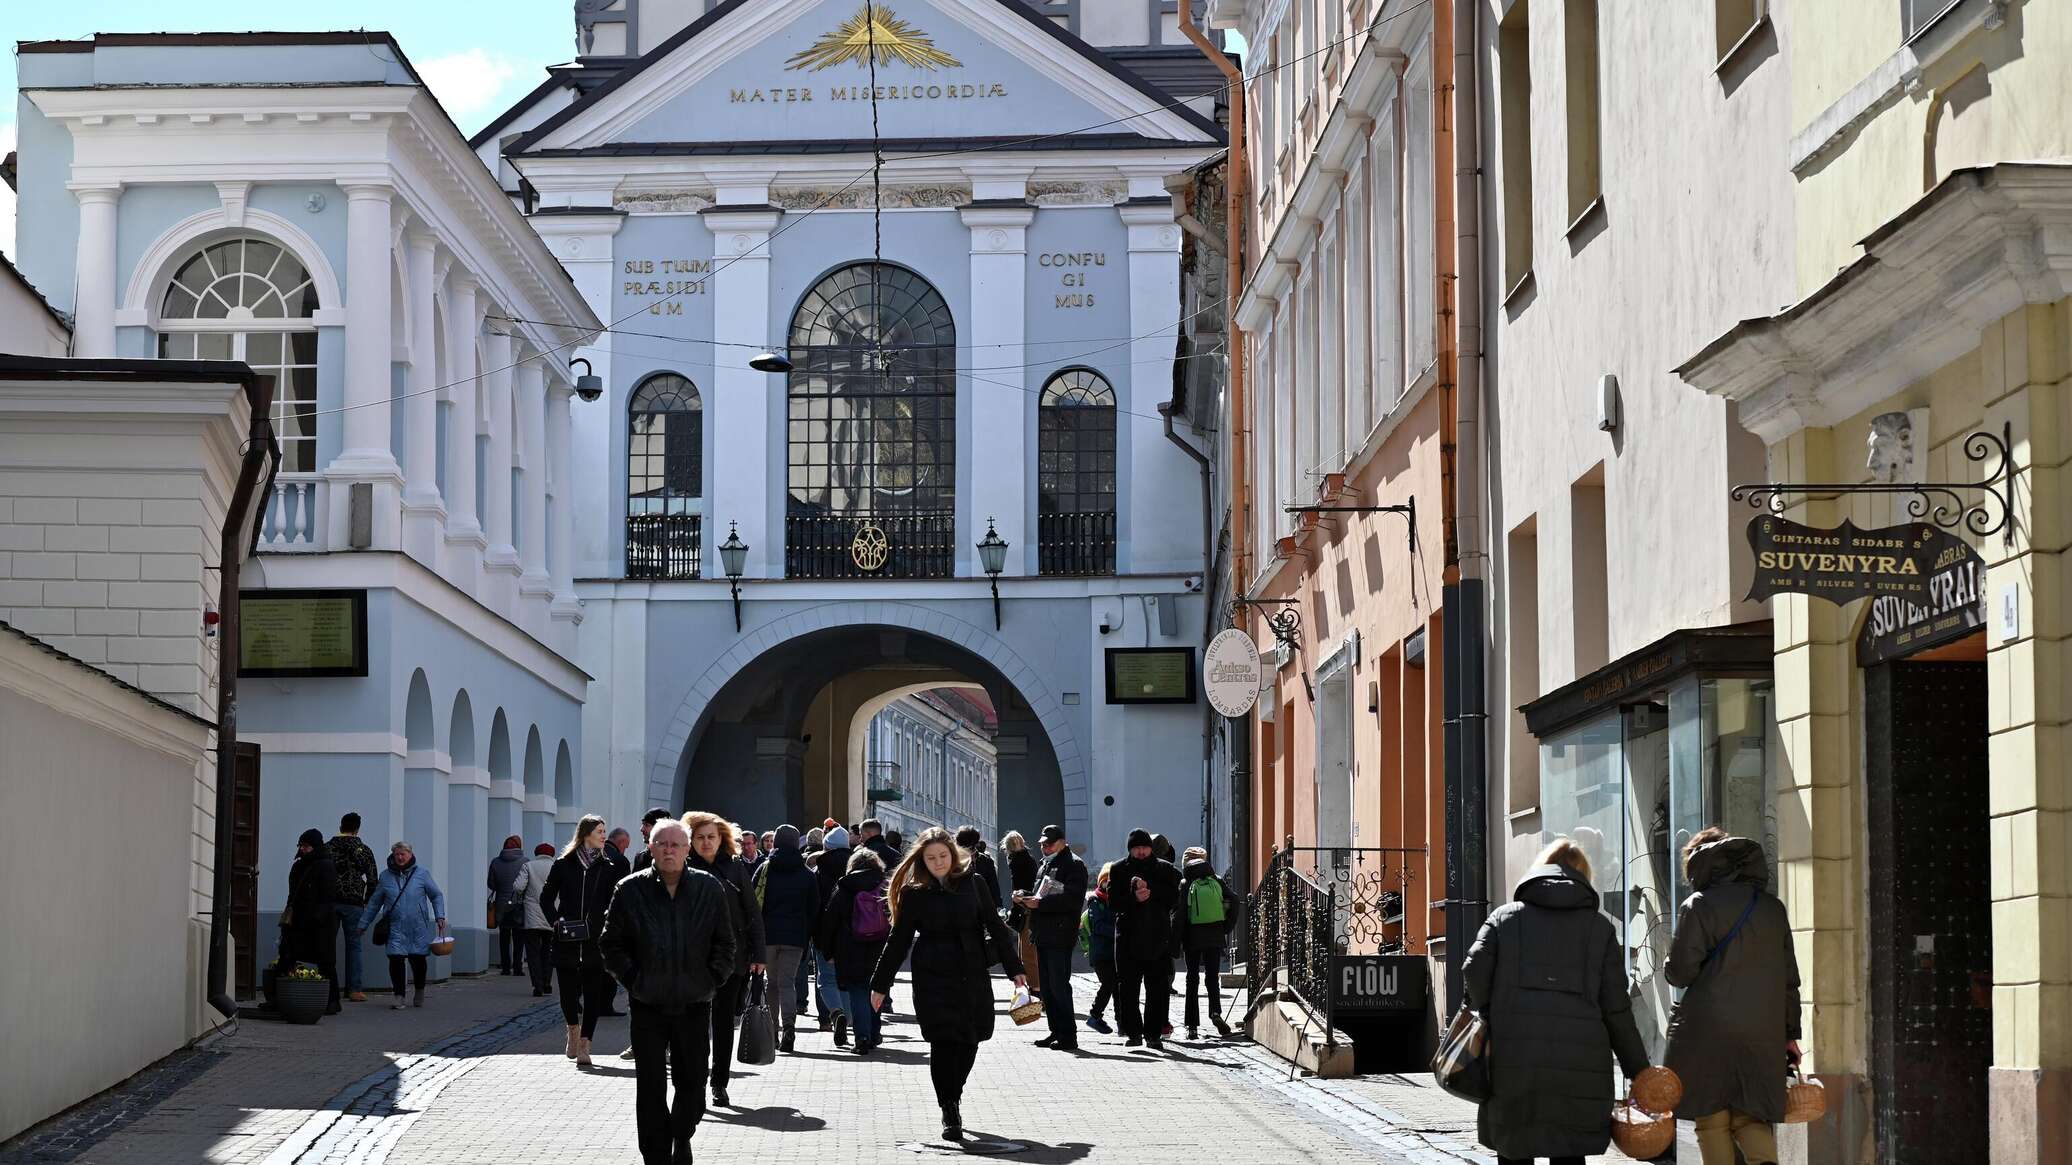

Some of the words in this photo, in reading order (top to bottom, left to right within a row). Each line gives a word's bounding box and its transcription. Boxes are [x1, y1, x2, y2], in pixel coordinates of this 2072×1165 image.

[730, 88, 813, 103] MATER
[624, 260, 654, 274] SUB
[660, 259, 710, 274] TUUM
[1039, 252, 1105, 267] CONFU
[1062, 272, 1084, 287] GI
[1055, 293, 1095, 308] MUS
[1772, 534, 1840, 546] GINTARAS
[1759, 551, 1919, 575] SUVENYRA
[1208, 689, 1256, 716] LOMBARDAS
